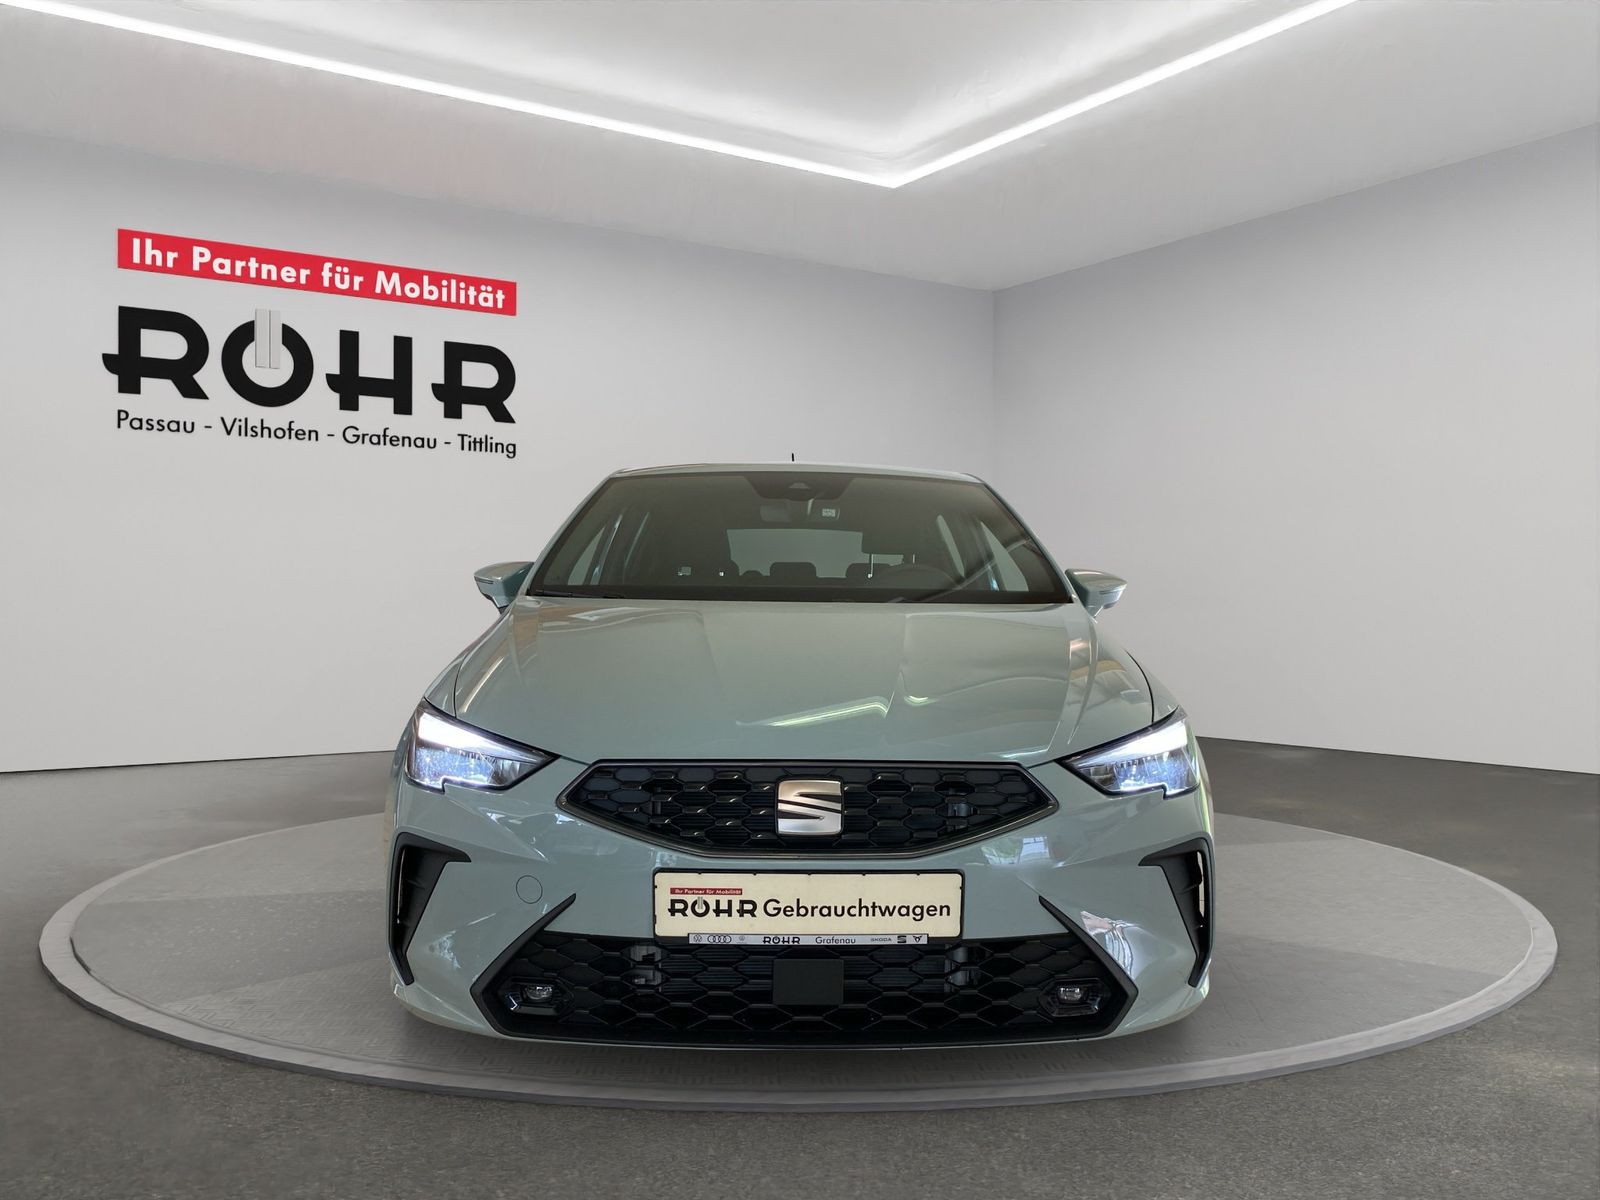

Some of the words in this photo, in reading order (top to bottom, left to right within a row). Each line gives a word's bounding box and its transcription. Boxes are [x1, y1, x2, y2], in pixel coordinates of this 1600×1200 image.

[131, 238, 178, 269] Ihr
[192, 246, 311, 285] Partner
[321, 262, 364, 291] für
[375, 271, 506, 309] Mobilität
[102, 305, 517, 424] RÖHR
[117, 409, 195, 434] Passau
[220, 416, 319, 442] Vilshofen
[342, 425, 437, 450] Grafenau
[457, 433, 517, 458] Tittling
[668, 897, 757, 918] RÖHR
[763, 898, 951, 922] Gebrauchtwagen
[762, 935, 800, 944] RÖHR
[815, 936, 856, 944] Grafenau
